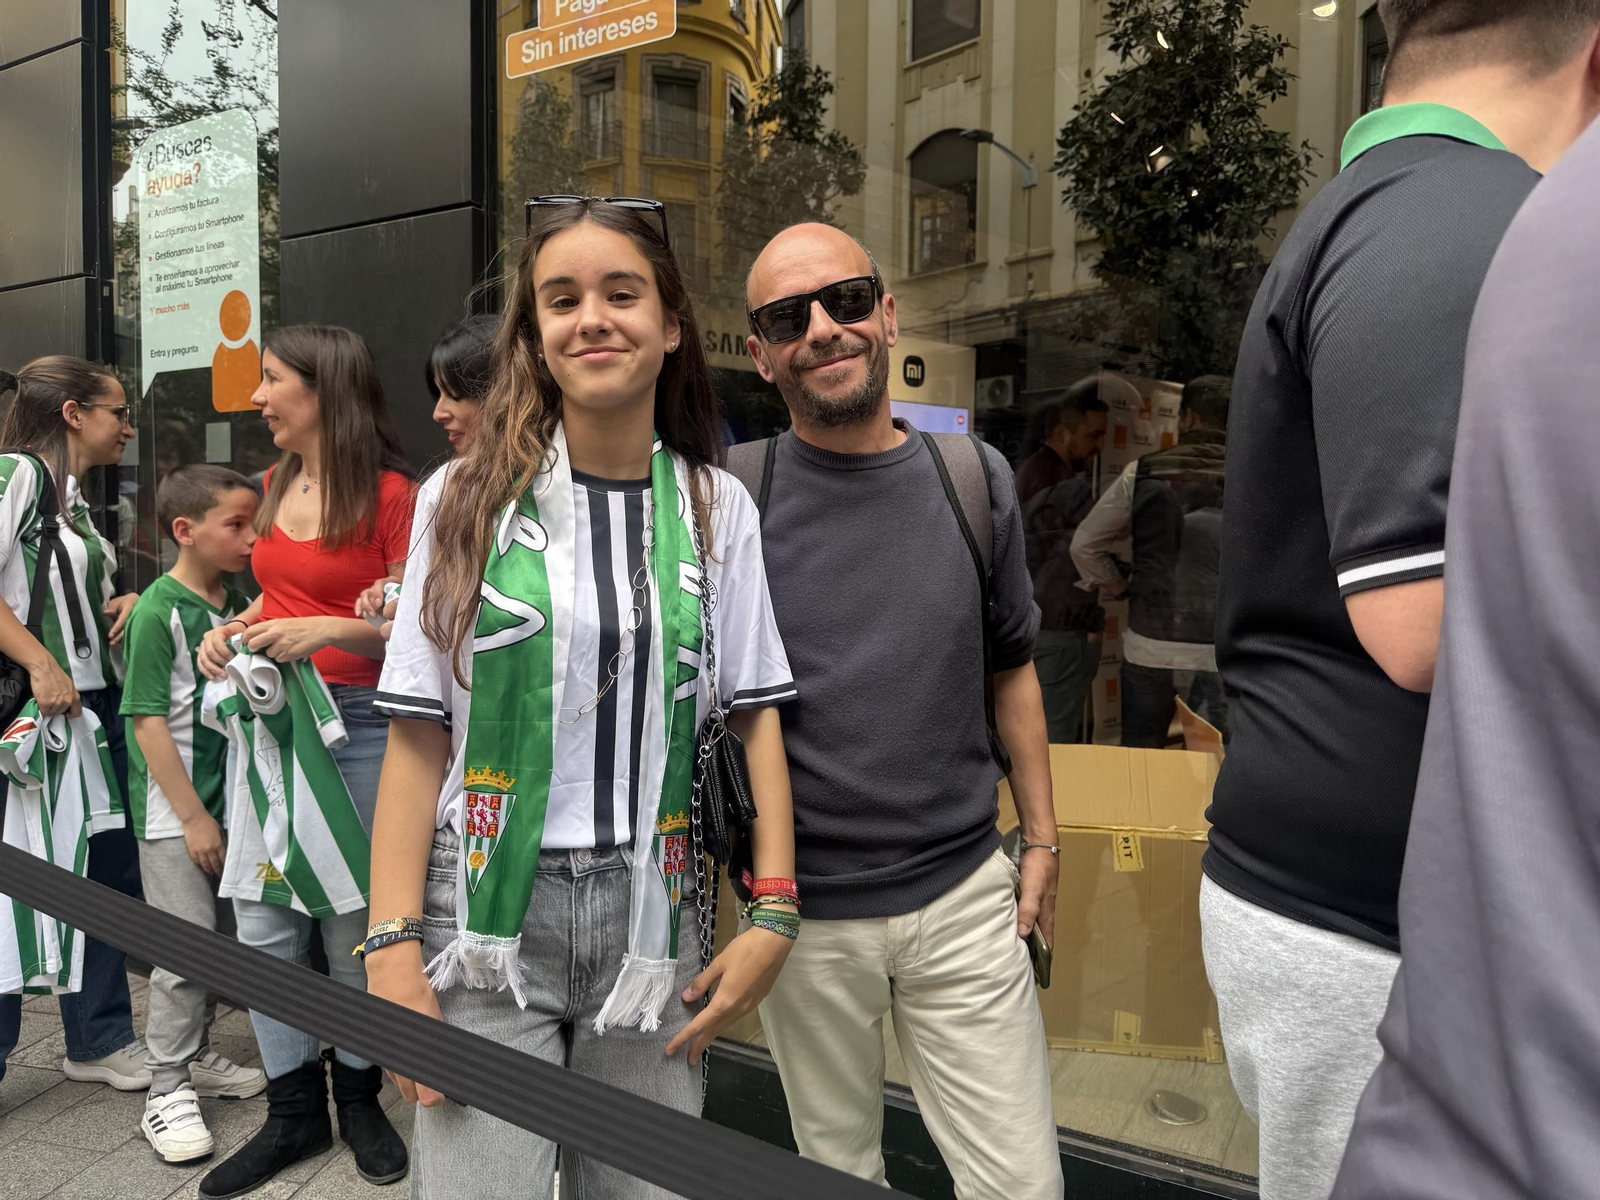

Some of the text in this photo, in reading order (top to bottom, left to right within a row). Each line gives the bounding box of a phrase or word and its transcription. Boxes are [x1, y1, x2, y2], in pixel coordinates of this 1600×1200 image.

[521, 11, 658, 64] Sin intereses
[147, 135, 212, 172] ¿Buscas
[147, 162, 202, 198] ayuda?
[154, 204, 188, 218] Analizamos
[197, 196, 220, 208] factura
[154, 213, 245, 239] Configuramos tu Smartphone
[155, 246, 194, 261] Gestionamos
[195, 244, 205, 253] tus
[155, 273, 162, 282] Te
[163, 269, 198, 282] enseñamos
[204, 260, 240, 275] aprovechar
[155, 273, 233, 293] al máximo tu Smartphone
[149, 306, 155, 315] Y
[155, 304, 176, 315] mucho
[150, 349, 166, 358] Entra
[171, 345, 199, 358] pregunta
